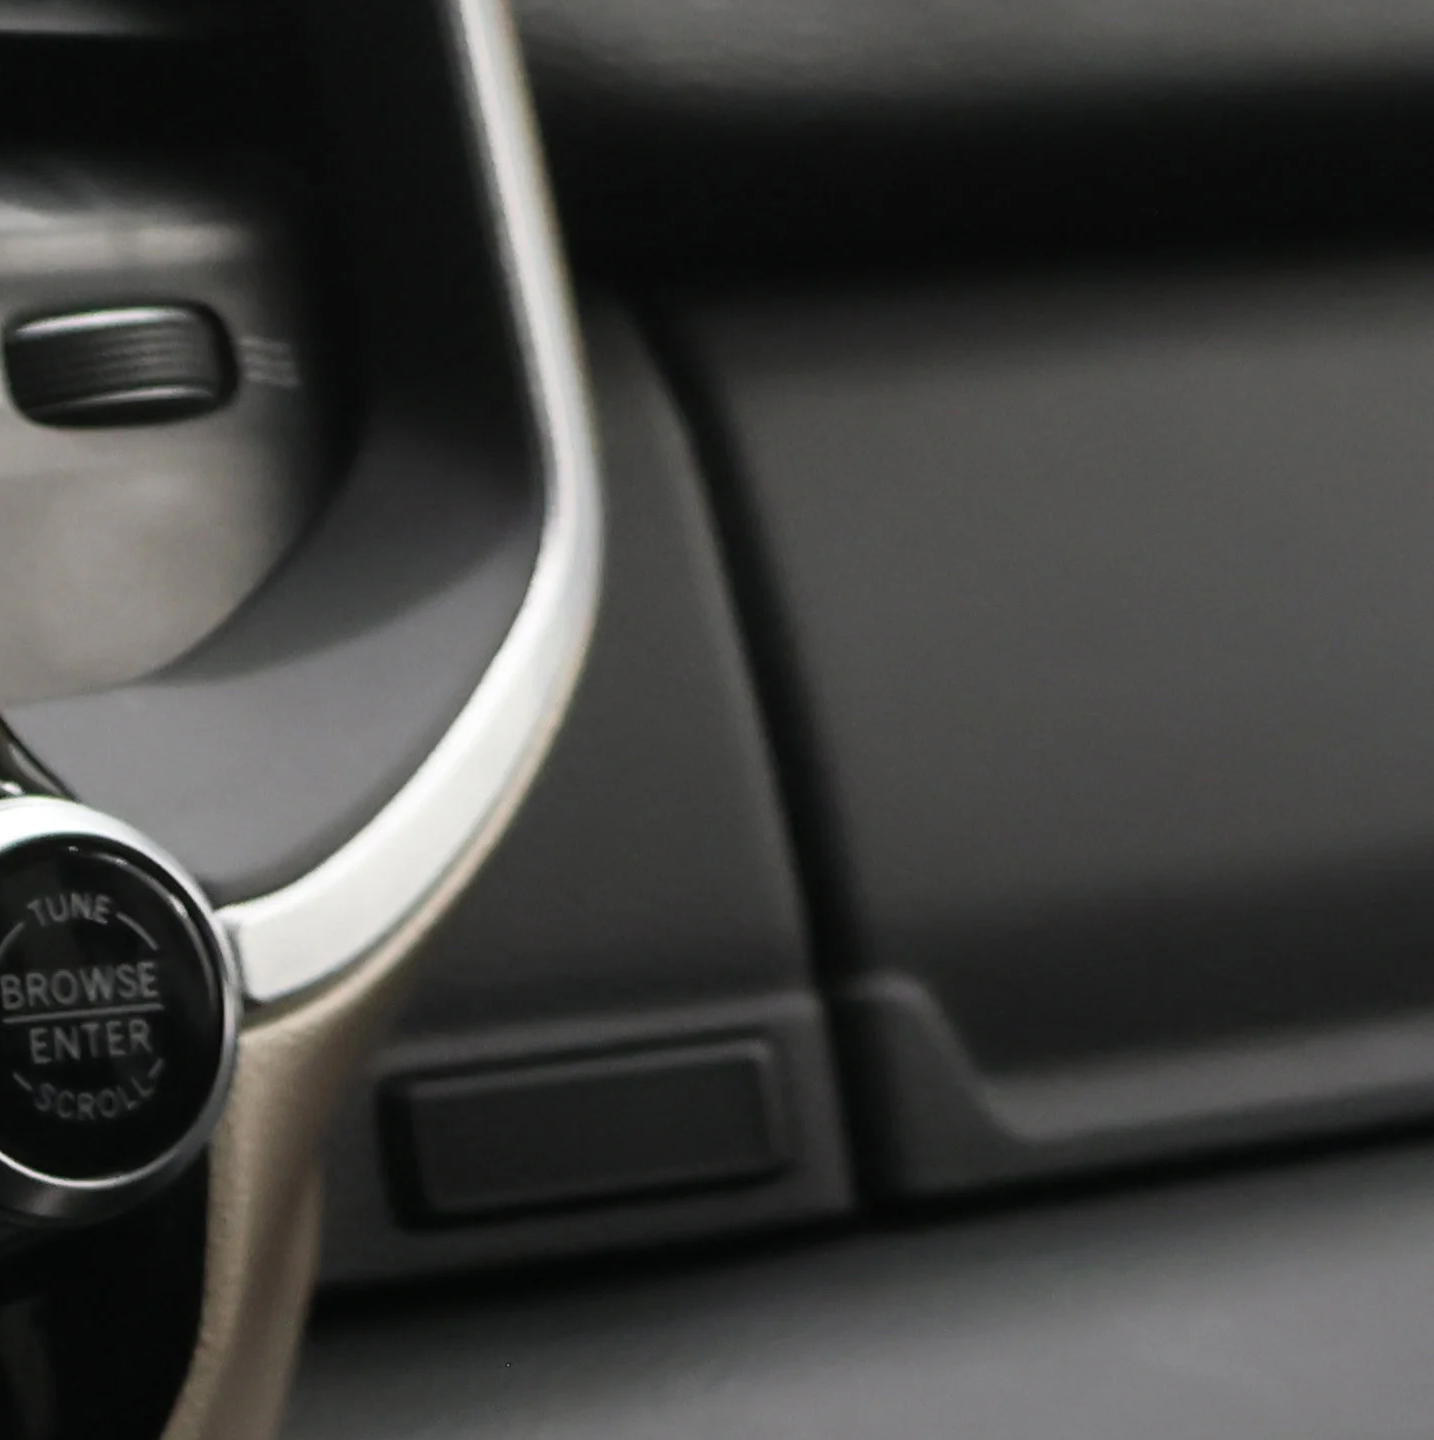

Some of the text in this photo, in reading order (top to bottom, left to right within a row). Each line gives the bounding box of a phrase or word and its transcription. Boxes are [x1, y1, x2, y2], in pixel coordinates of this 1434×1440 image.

[25, 891, 111, 927] TUNE
[0, 962, 161, 1011] BROWSE
[26, 1017, 152, 1065] ENTER
[34, 1072, 155, 1121] SCROLL
